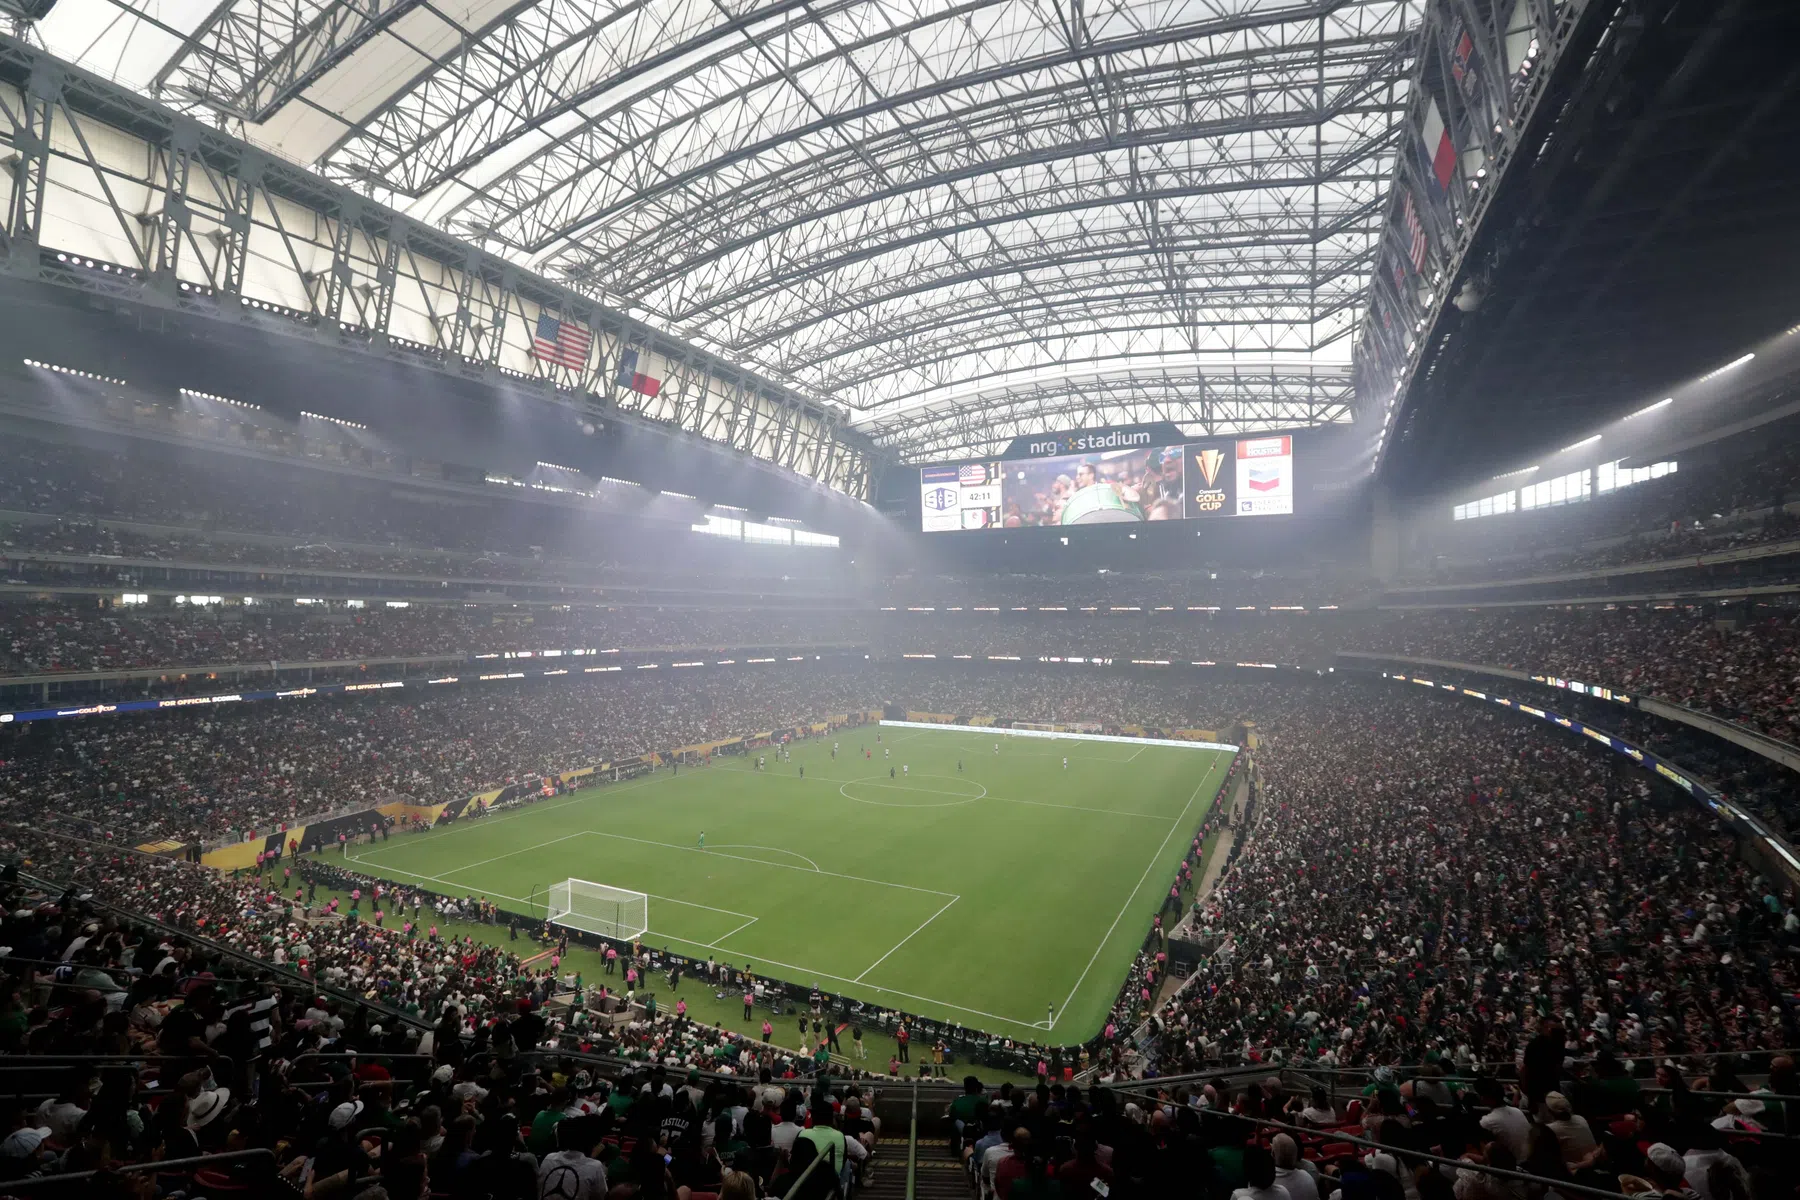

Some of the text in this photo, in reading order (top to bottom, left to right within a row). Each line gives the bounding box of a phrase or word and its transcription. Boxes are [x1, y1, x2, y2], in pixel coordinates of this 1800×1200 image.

[1030, 431, 1150, 456] nrg stadium
[989, 467, 995, 478] 1
[969, 492, 990, 500] 42:11
[1196, 494, 1225, 503] GOLD
[1200, 502, 1222, 511] CUP
[990, 511, 996, 522] 1
[177, 697, 211, 706] OFFICIAL
[660, 1117, 689, 1130] CASTILLO
